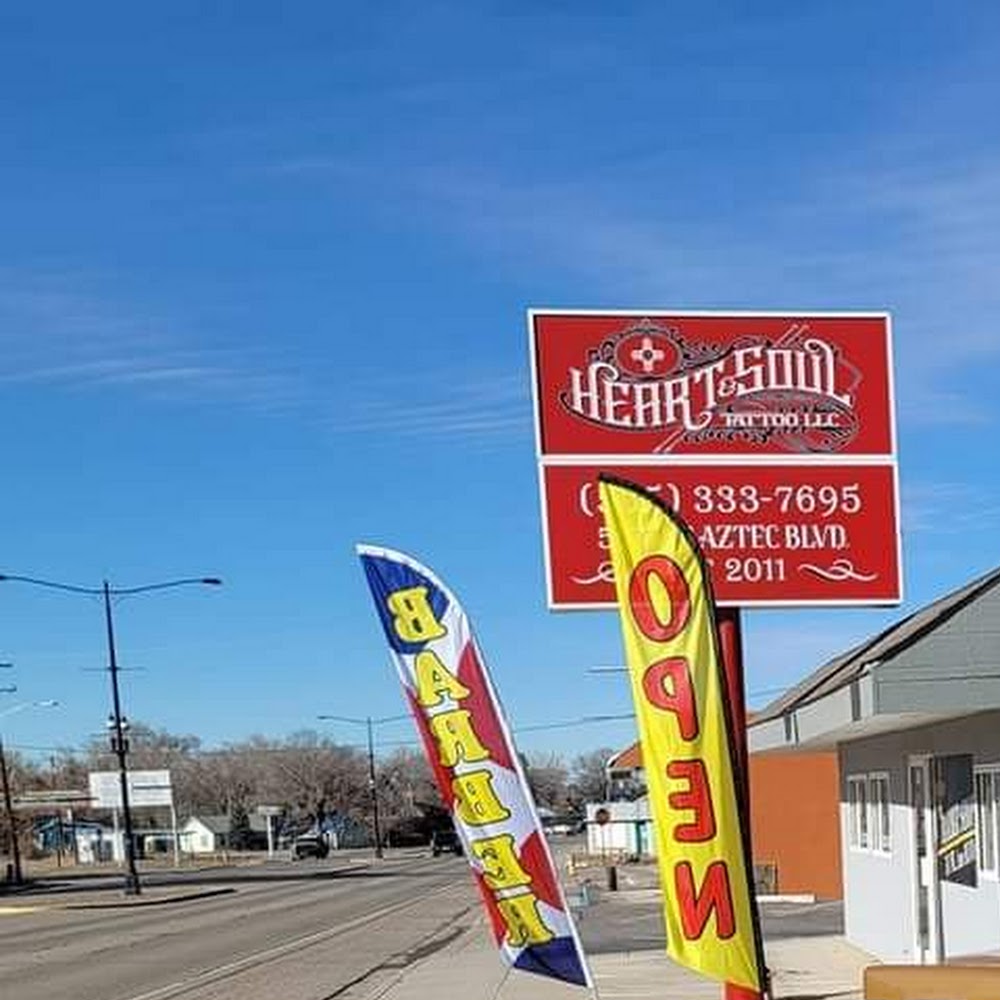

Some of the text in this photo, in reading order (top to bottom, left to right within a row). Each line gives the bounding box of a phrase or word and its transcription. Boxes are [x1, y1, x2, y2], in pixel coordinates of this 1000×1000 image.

[570, 339, 853, 430] HEART & SOUL
[720, 412, 841, 428] TATTOO LLC
[693, 484, 861, 516] 333-7695
[699, 524, 781, 549] AZTEC
[725, 557, 785, 583] 2011
